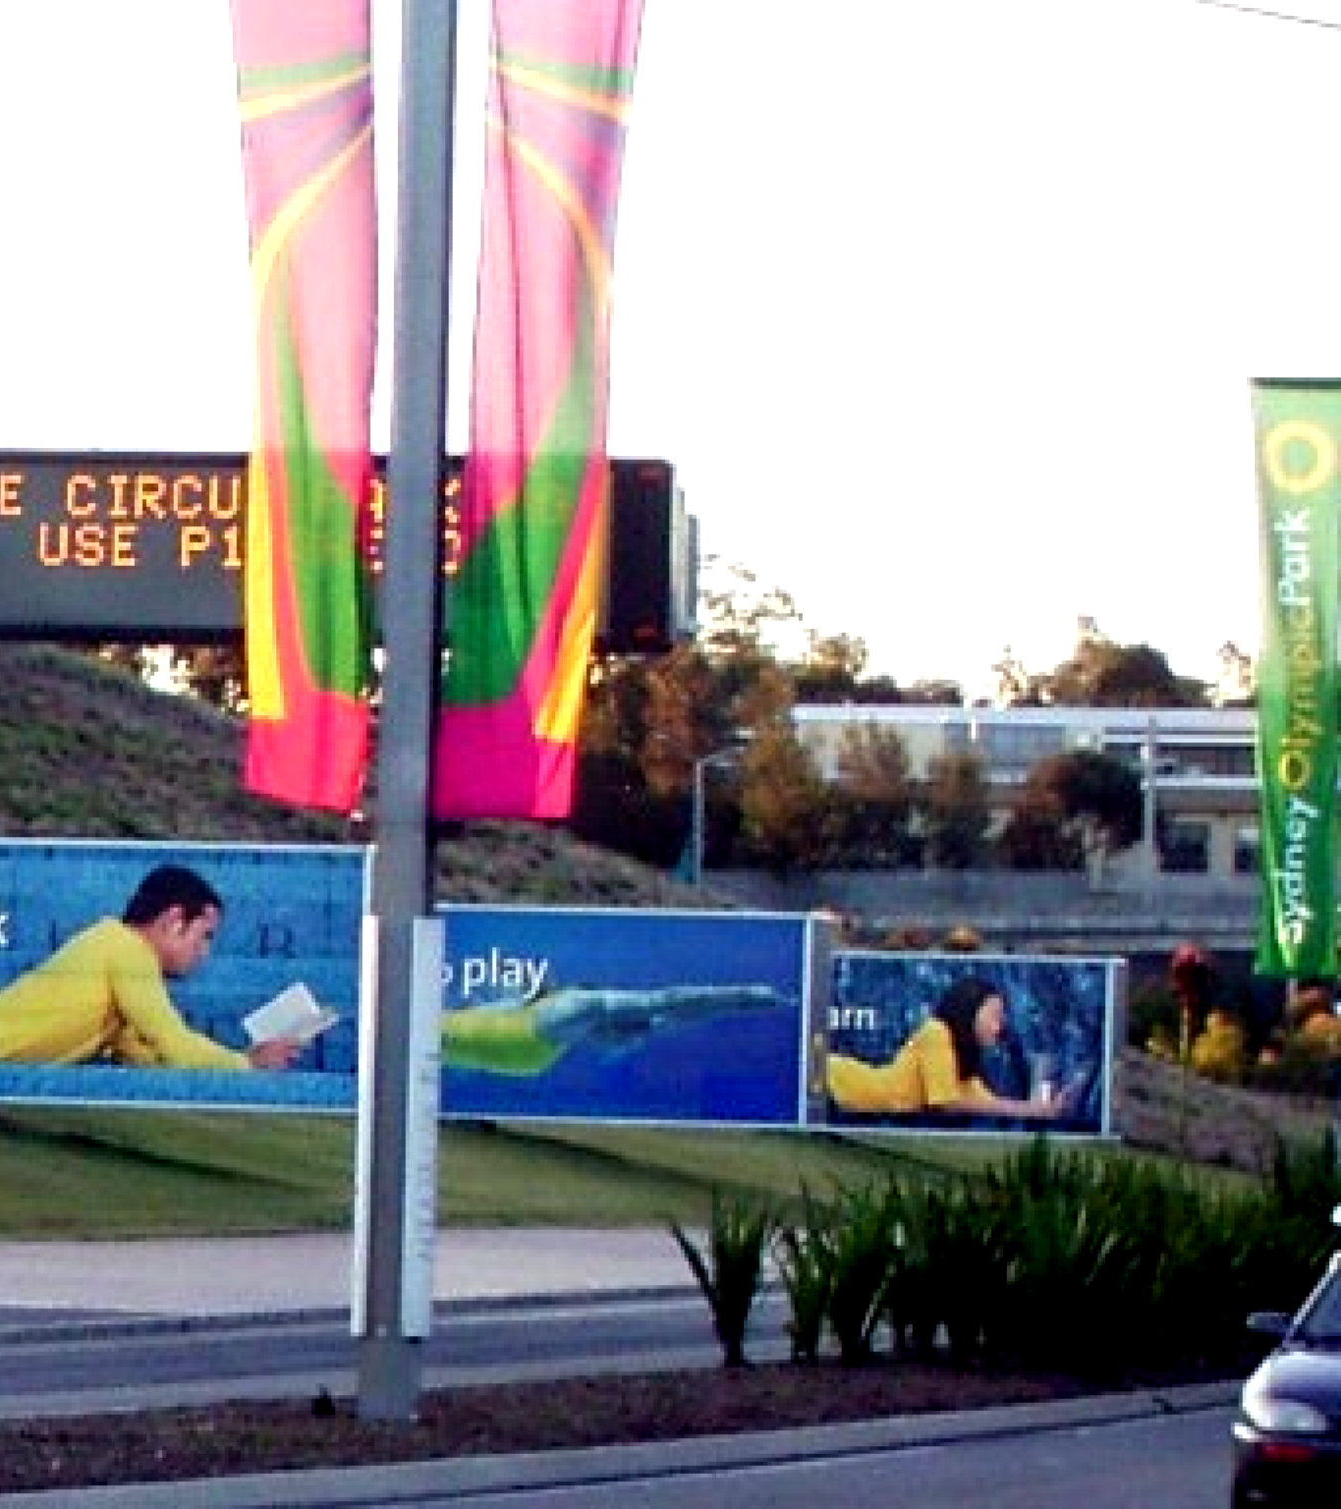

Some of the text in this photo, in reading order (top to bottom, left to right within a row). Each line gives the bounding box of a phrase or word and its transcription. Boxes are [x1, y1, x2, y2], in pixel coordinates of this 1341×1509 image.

[66, 474, 241, 519] CIRCU
[38, 523, 135, 567] USE
[462, 947, 548, 999] play
